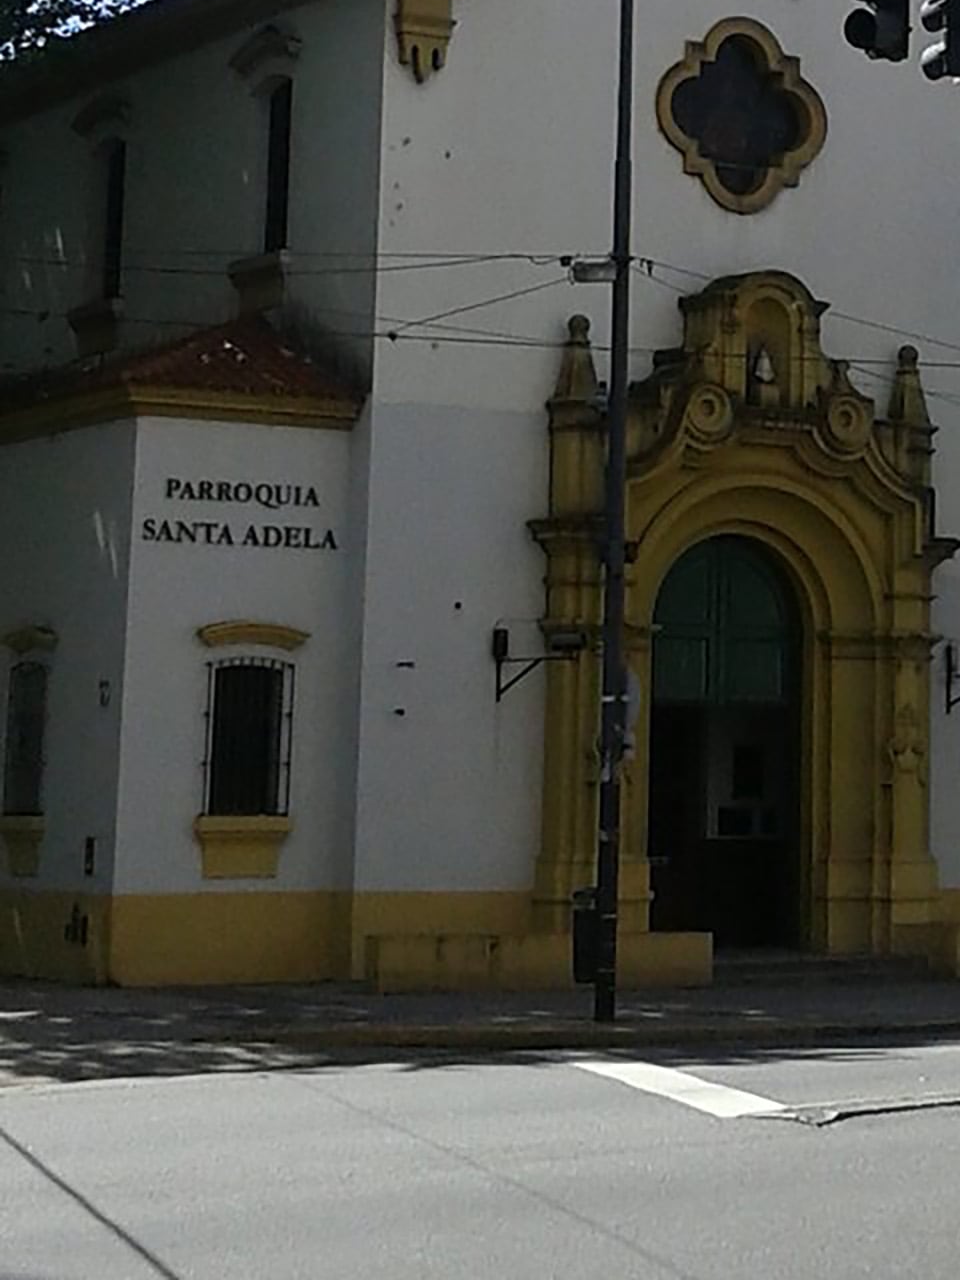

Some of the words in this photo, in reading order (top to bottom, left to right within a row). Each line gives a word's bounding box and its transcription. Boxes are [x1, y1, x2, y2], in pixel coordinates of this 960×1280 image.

[165, 478, 320, 509] PARROQUIA
[142, 518, 234, 545] SANTA
[242, 525, 338, 550] ADELA
